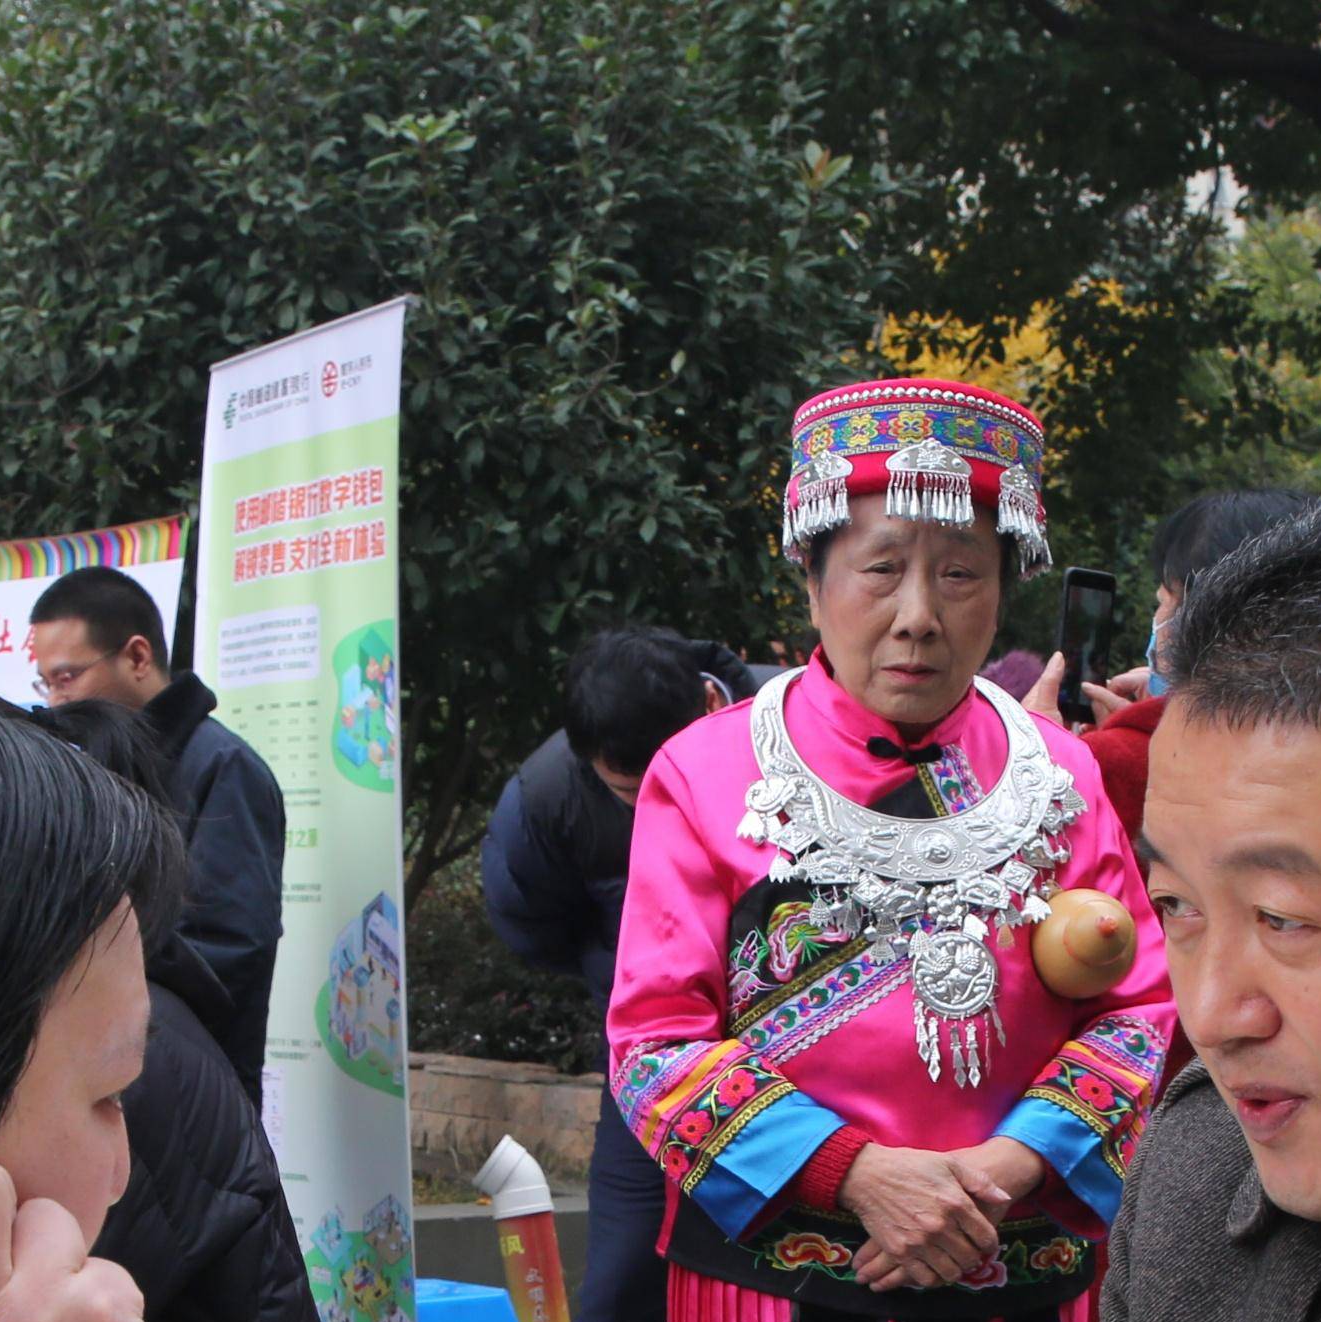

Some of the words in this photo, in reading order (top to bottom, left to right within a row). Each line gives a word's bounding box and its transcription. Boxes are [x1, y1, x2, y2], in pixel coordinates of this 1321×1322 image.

[234, 468, 384, 534] 使用邮储银行数字钱包
